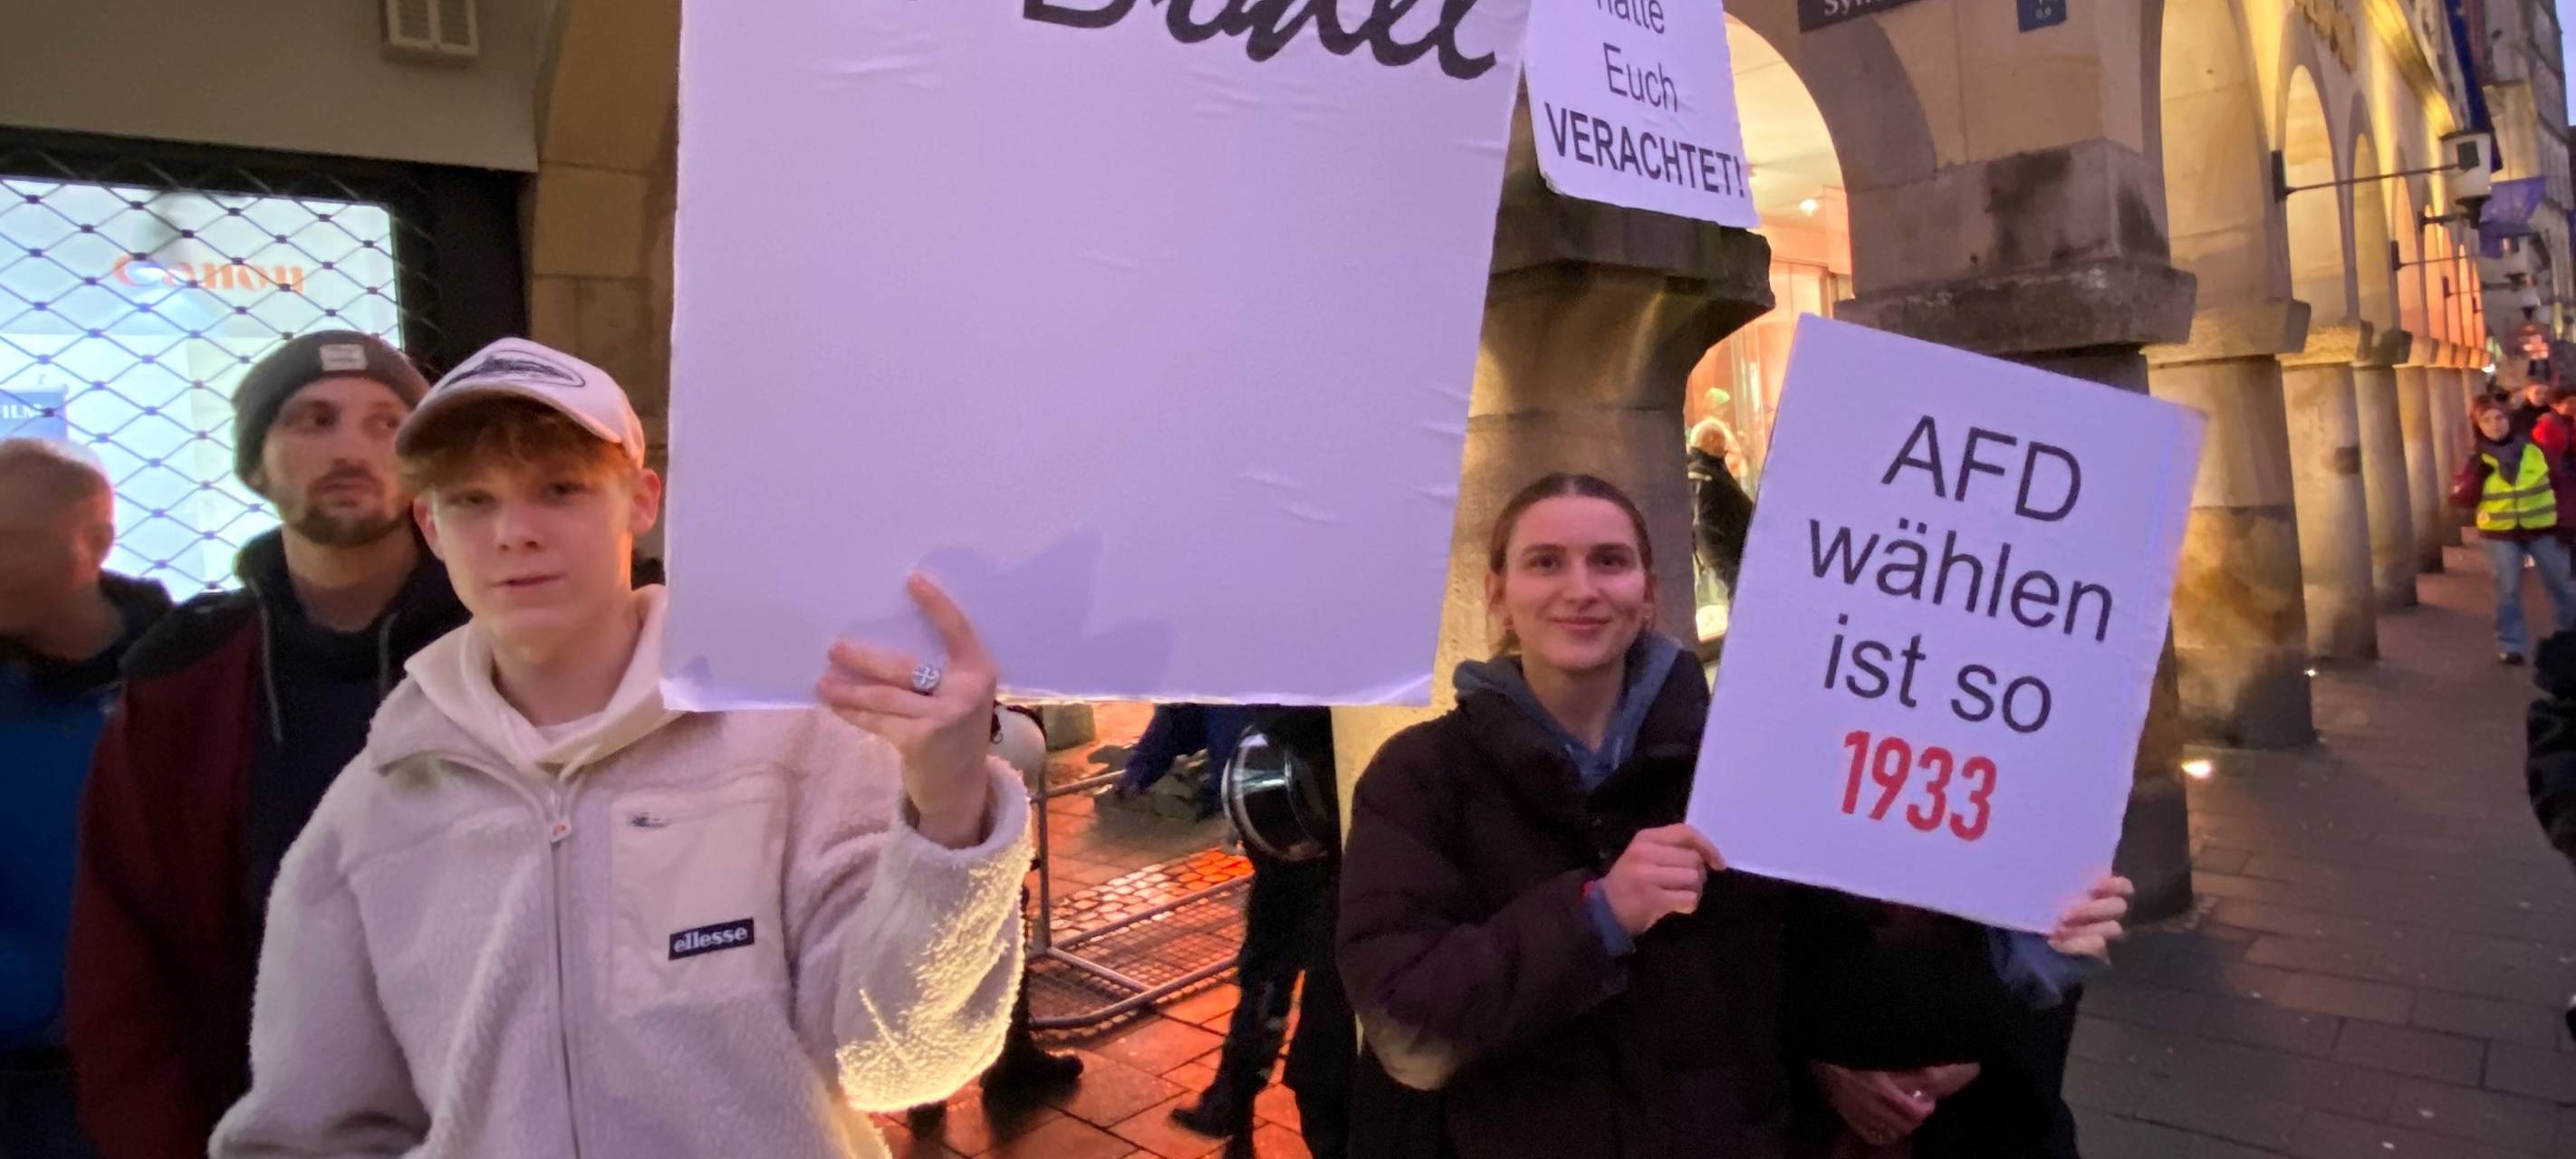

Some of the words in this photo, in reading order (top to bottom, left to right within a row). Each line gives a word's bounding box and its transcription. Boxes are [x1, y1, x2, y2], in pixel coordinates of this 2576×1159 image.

[1602, 42, 1678, 112] Euch
[1544, 101, 1745, 198] VERACHTET!
[111, 254, 304, 292] Canon
[1881, 415, 2082, 522] AFD
[1809, 517, 2113, 642] wählen
[1824, 613, 1927, 708] ist
[1951, 664, 2052, 733] so
[1841, 730, 1997, 841] 1933
[673, 926, 748, 953] ellesse
